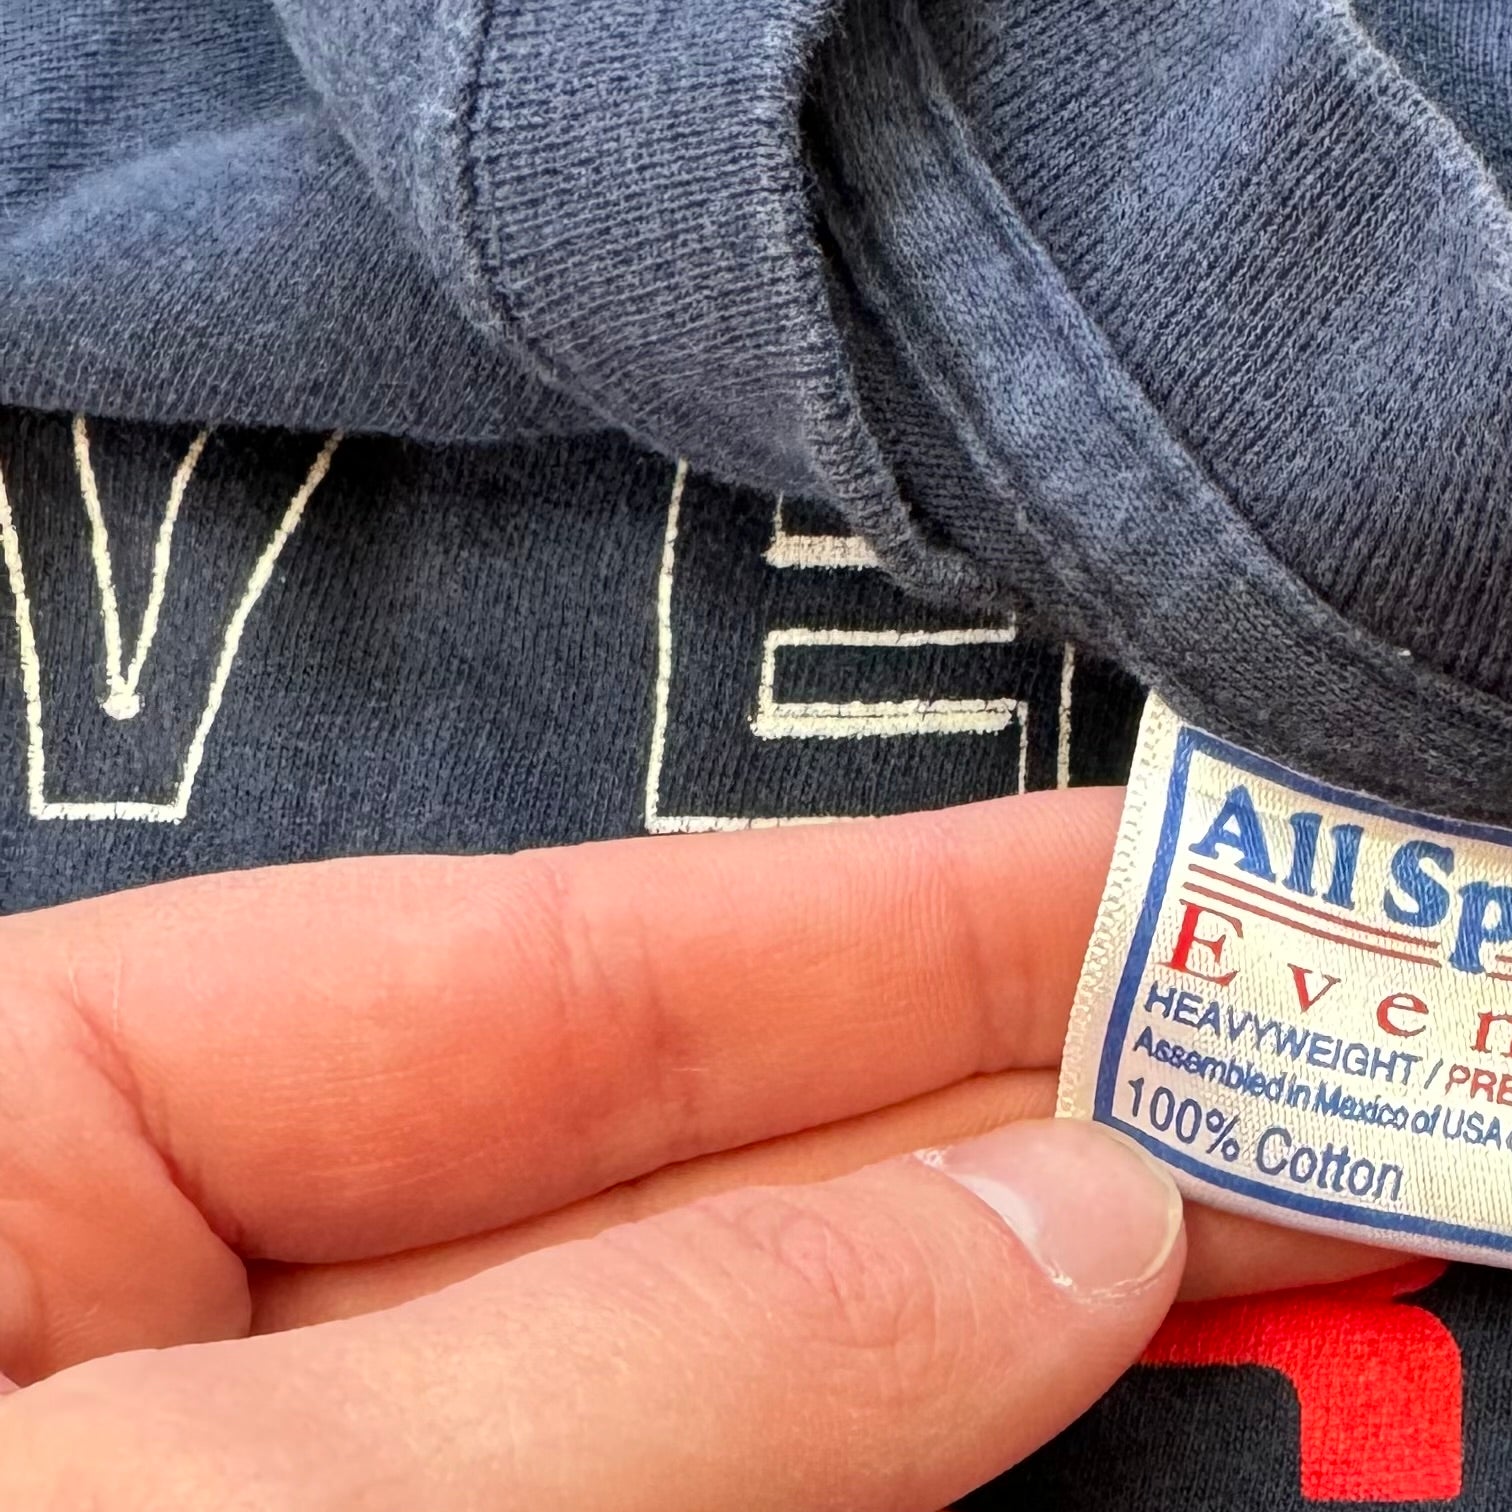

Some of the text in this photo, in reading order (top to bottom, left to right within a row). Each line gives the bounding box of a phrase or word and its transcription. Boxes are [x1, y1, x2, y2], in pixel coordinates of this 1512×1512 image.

[1188, 783, 1364, 909] All
[1134, 1026, 1287, 1101] Assembled
[1285, 1072, 1312, 1111] in
[1315, 1079, 1407, 1131] Mexico
[1411, 1104, 1442, 1136] of
[1442, 1108, 1501, 1150] USA
[1144, 980, 1423, 1086] HEAVYWEIGHT
[1128, 1077, 1404, 1202] 100% Cotton
